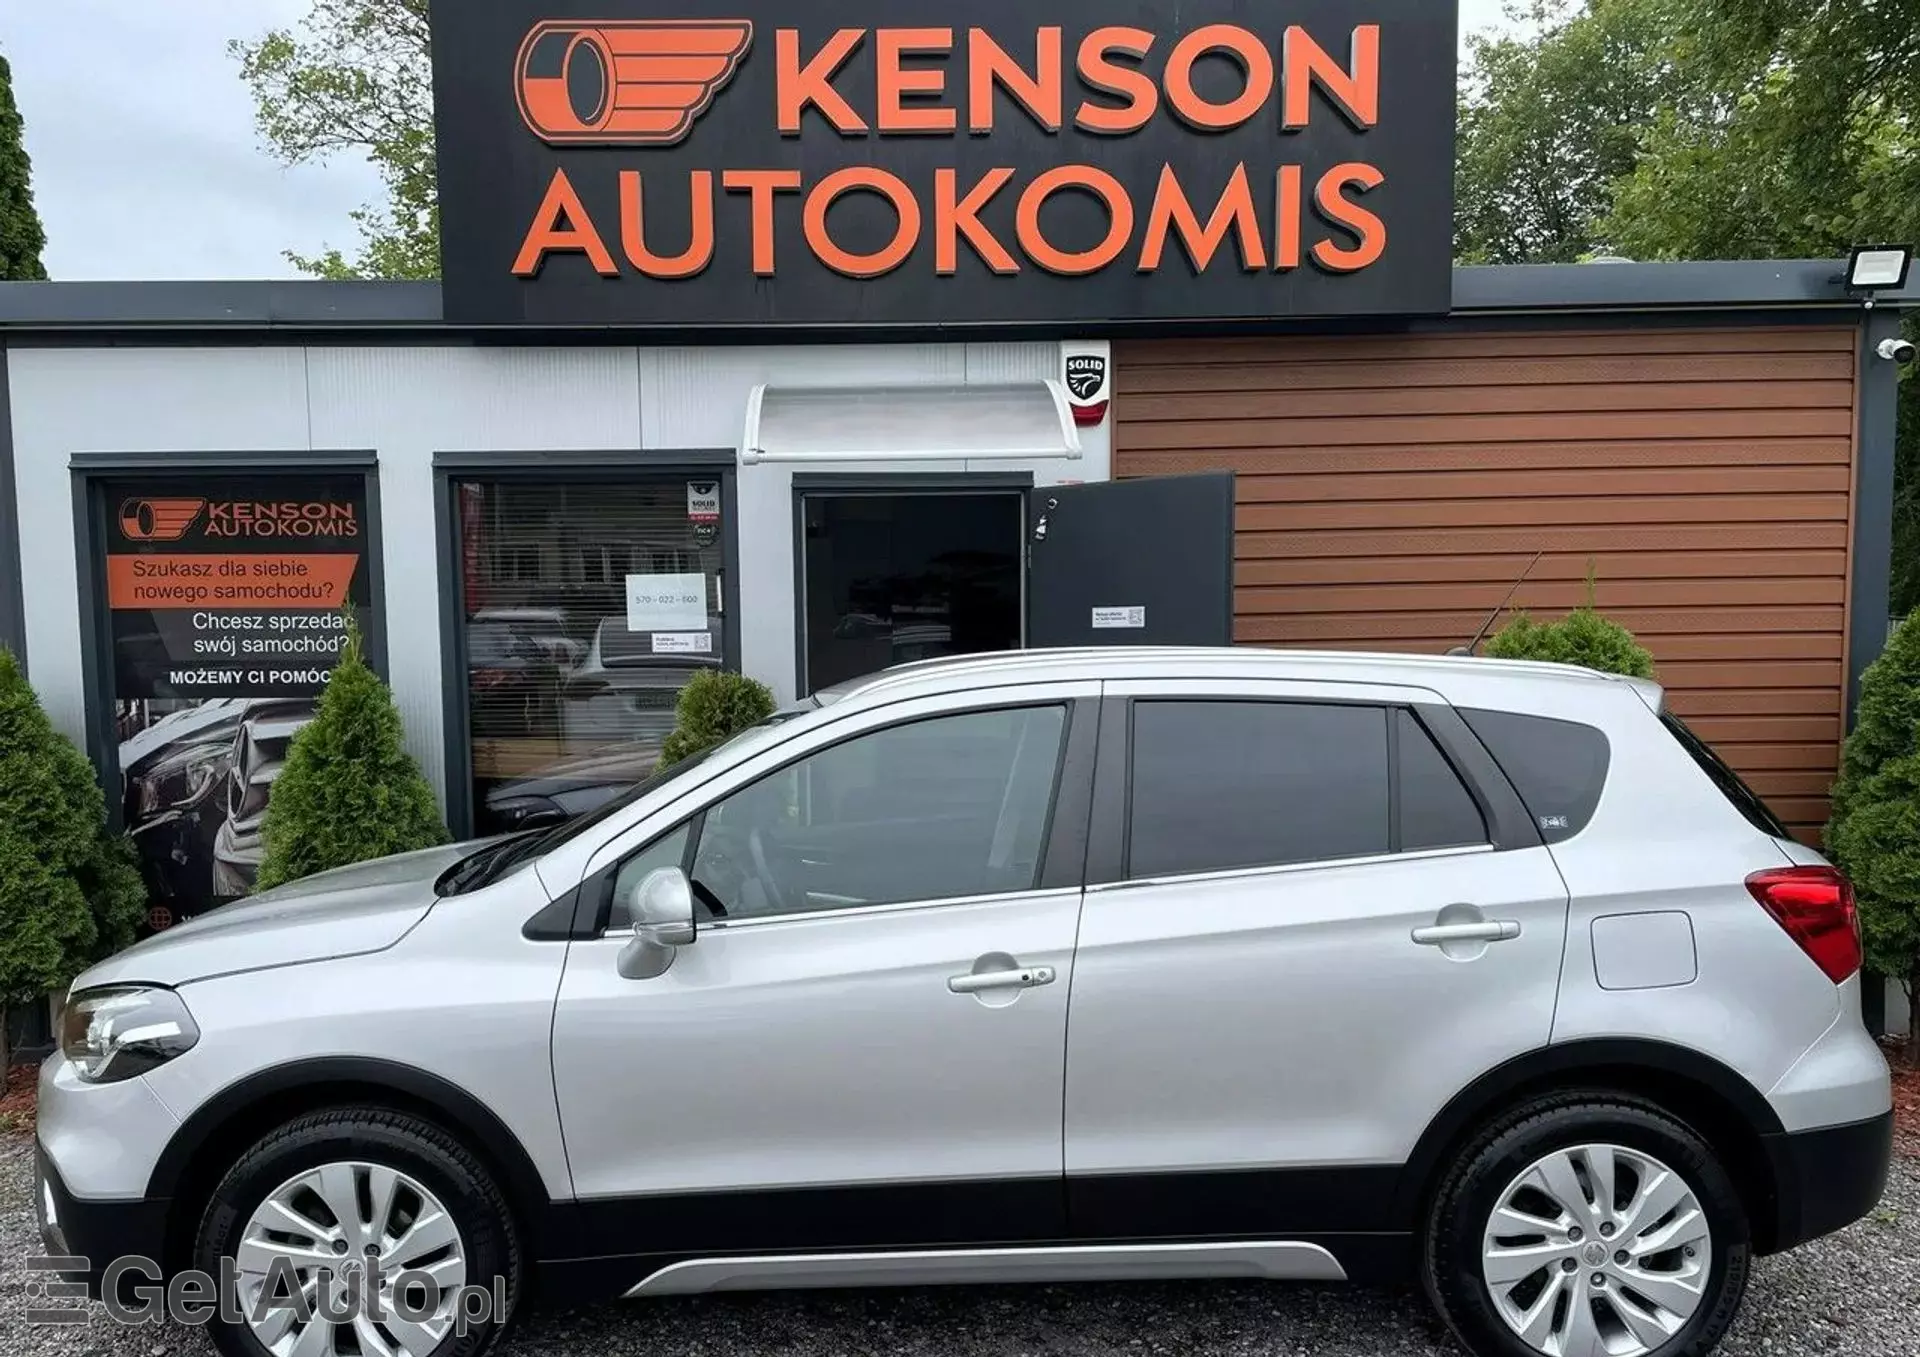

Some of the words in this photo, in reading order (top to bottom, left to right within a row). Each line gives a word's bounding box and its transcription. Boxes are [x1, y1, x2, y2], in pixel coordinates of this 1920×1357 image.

[775, 23, 1381, 136] KENSON
[511, 160, 1387, 280] AUTOKOMIS
[1068, 359, 1103, 370] SOLID
[208, 502, 354, 519] KENSON
[204, 519, 359, 537] AUTOKOMIS
[133, 560, 213, 577] Szukasz
[218, 560, 247, 577] dla
[252, 560, 308, 577] siebie
[134, 583, 209, 603] nowego
[213, 582, 335, 599] samochodu?
[192, 611, 264, 630] Chcesz
[193, 635, 237, 657] swój
[241, 634, 350, 653] samochód?
[169, 667, 244, 685] MOŻEMY
[247, 671, 265, 685] CI
